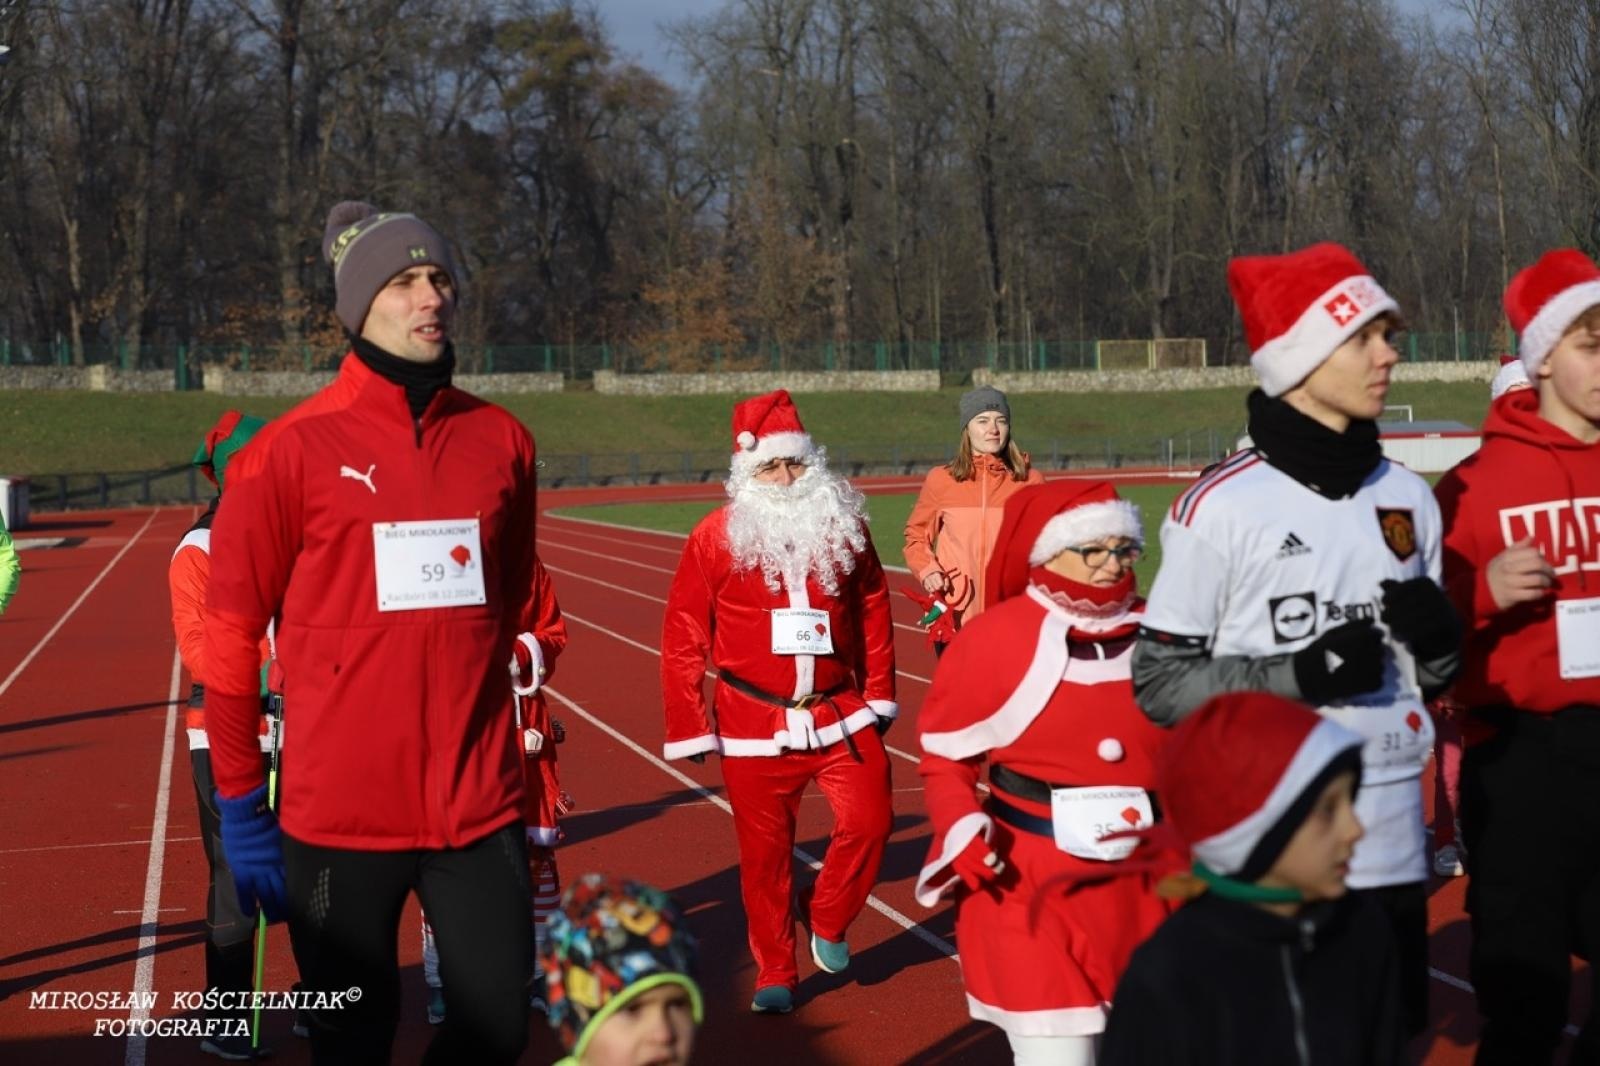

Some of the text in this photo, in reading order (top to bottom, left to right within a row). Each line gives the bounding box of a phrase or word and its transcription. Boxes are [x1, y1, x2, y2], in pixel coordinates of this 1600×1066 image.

[385, 529, 407, 539] BIEG
[421, 563, 446, 583] 59
[796, 630, 811, 642] 66
[1382, 732, 1401, 752] 31
